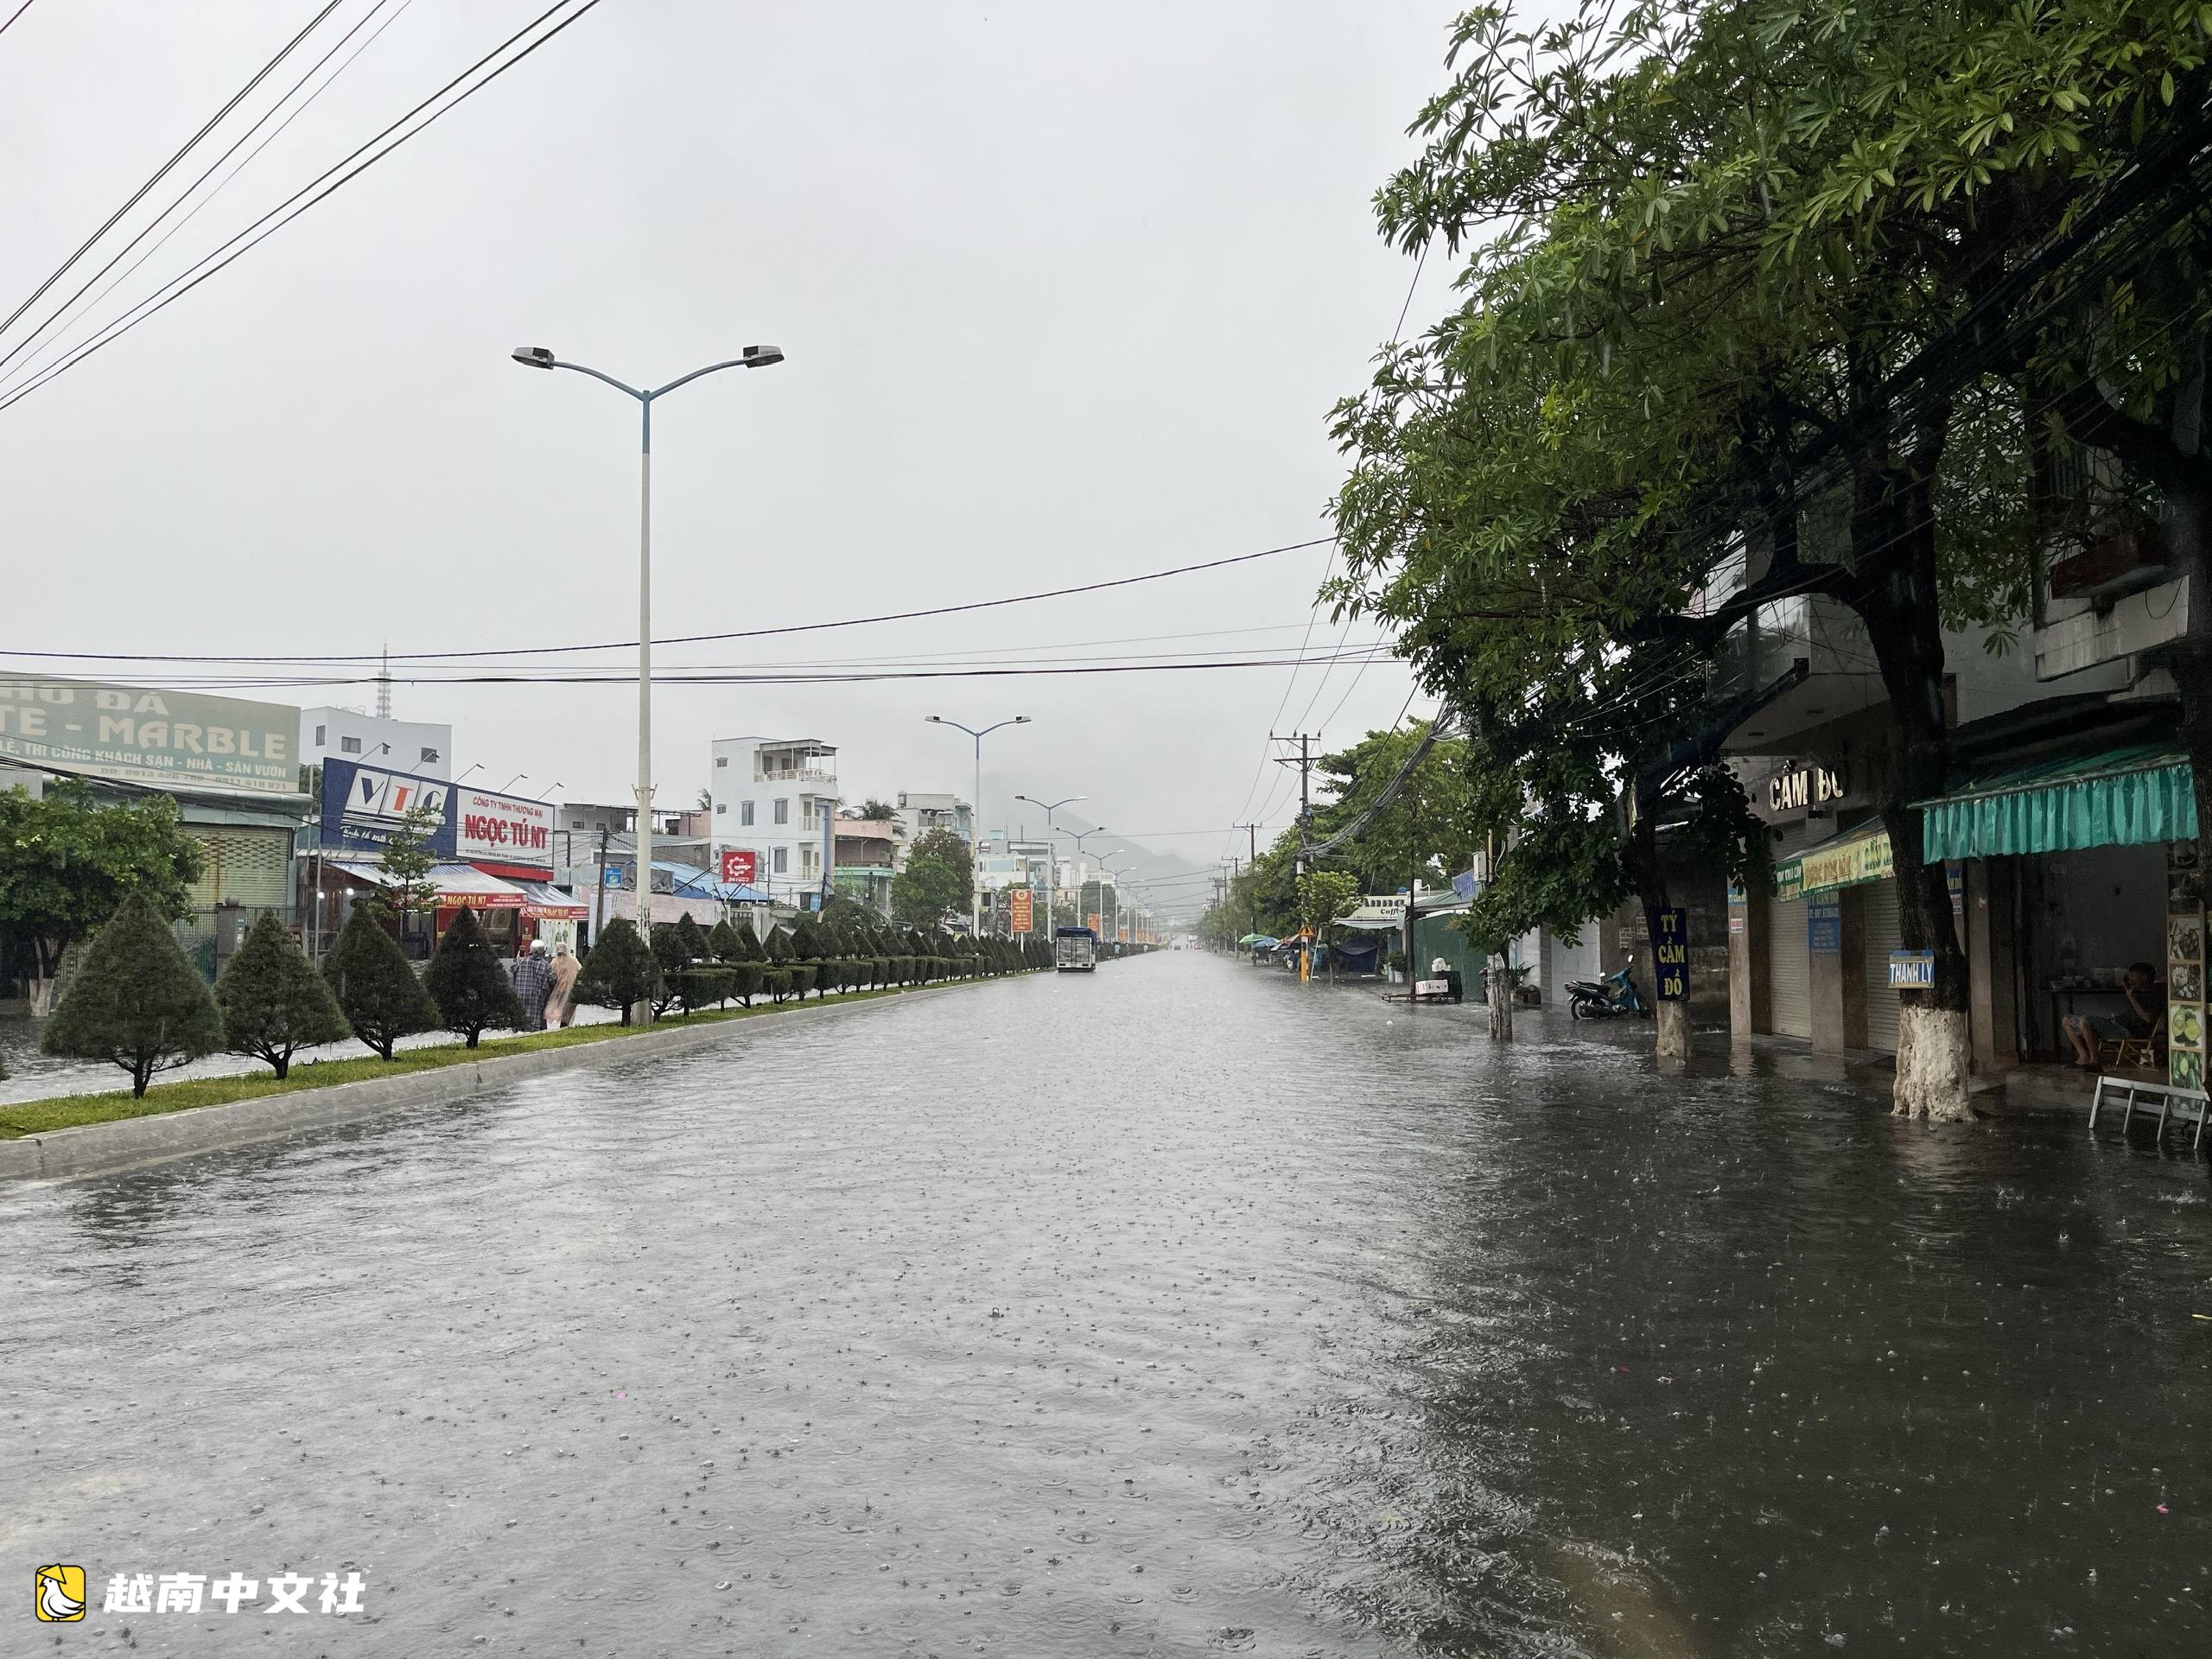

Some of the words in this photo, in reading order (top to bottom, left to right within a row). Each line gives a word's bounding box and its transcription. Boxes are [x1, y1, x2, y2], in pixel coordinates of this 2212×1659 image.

[99, 715, 287, 760] MARBLE
[25, 742, 47, 757] THI
[52, 745, 91, 761] CÔNG
[95, 749, 142, 766] KHÁCH
[145, 755, 173, 768] SẠN
[186, 757, 213, 771] NHÀ
[360, 777, 442, 812] VTC
[473, 795, 488, 808] CÔNG
[490, 800, 497, 810] TY
[512, 804, 534, 815] THƯƠNG
[465, 814, 508, 848] NGỌC
[511, 817, 529, 846] TÚ
[531, 825, 549, 850] NT
[1660, 910, 1678, 933] TÝ
[1890, 963, 1919, 983] THANH
